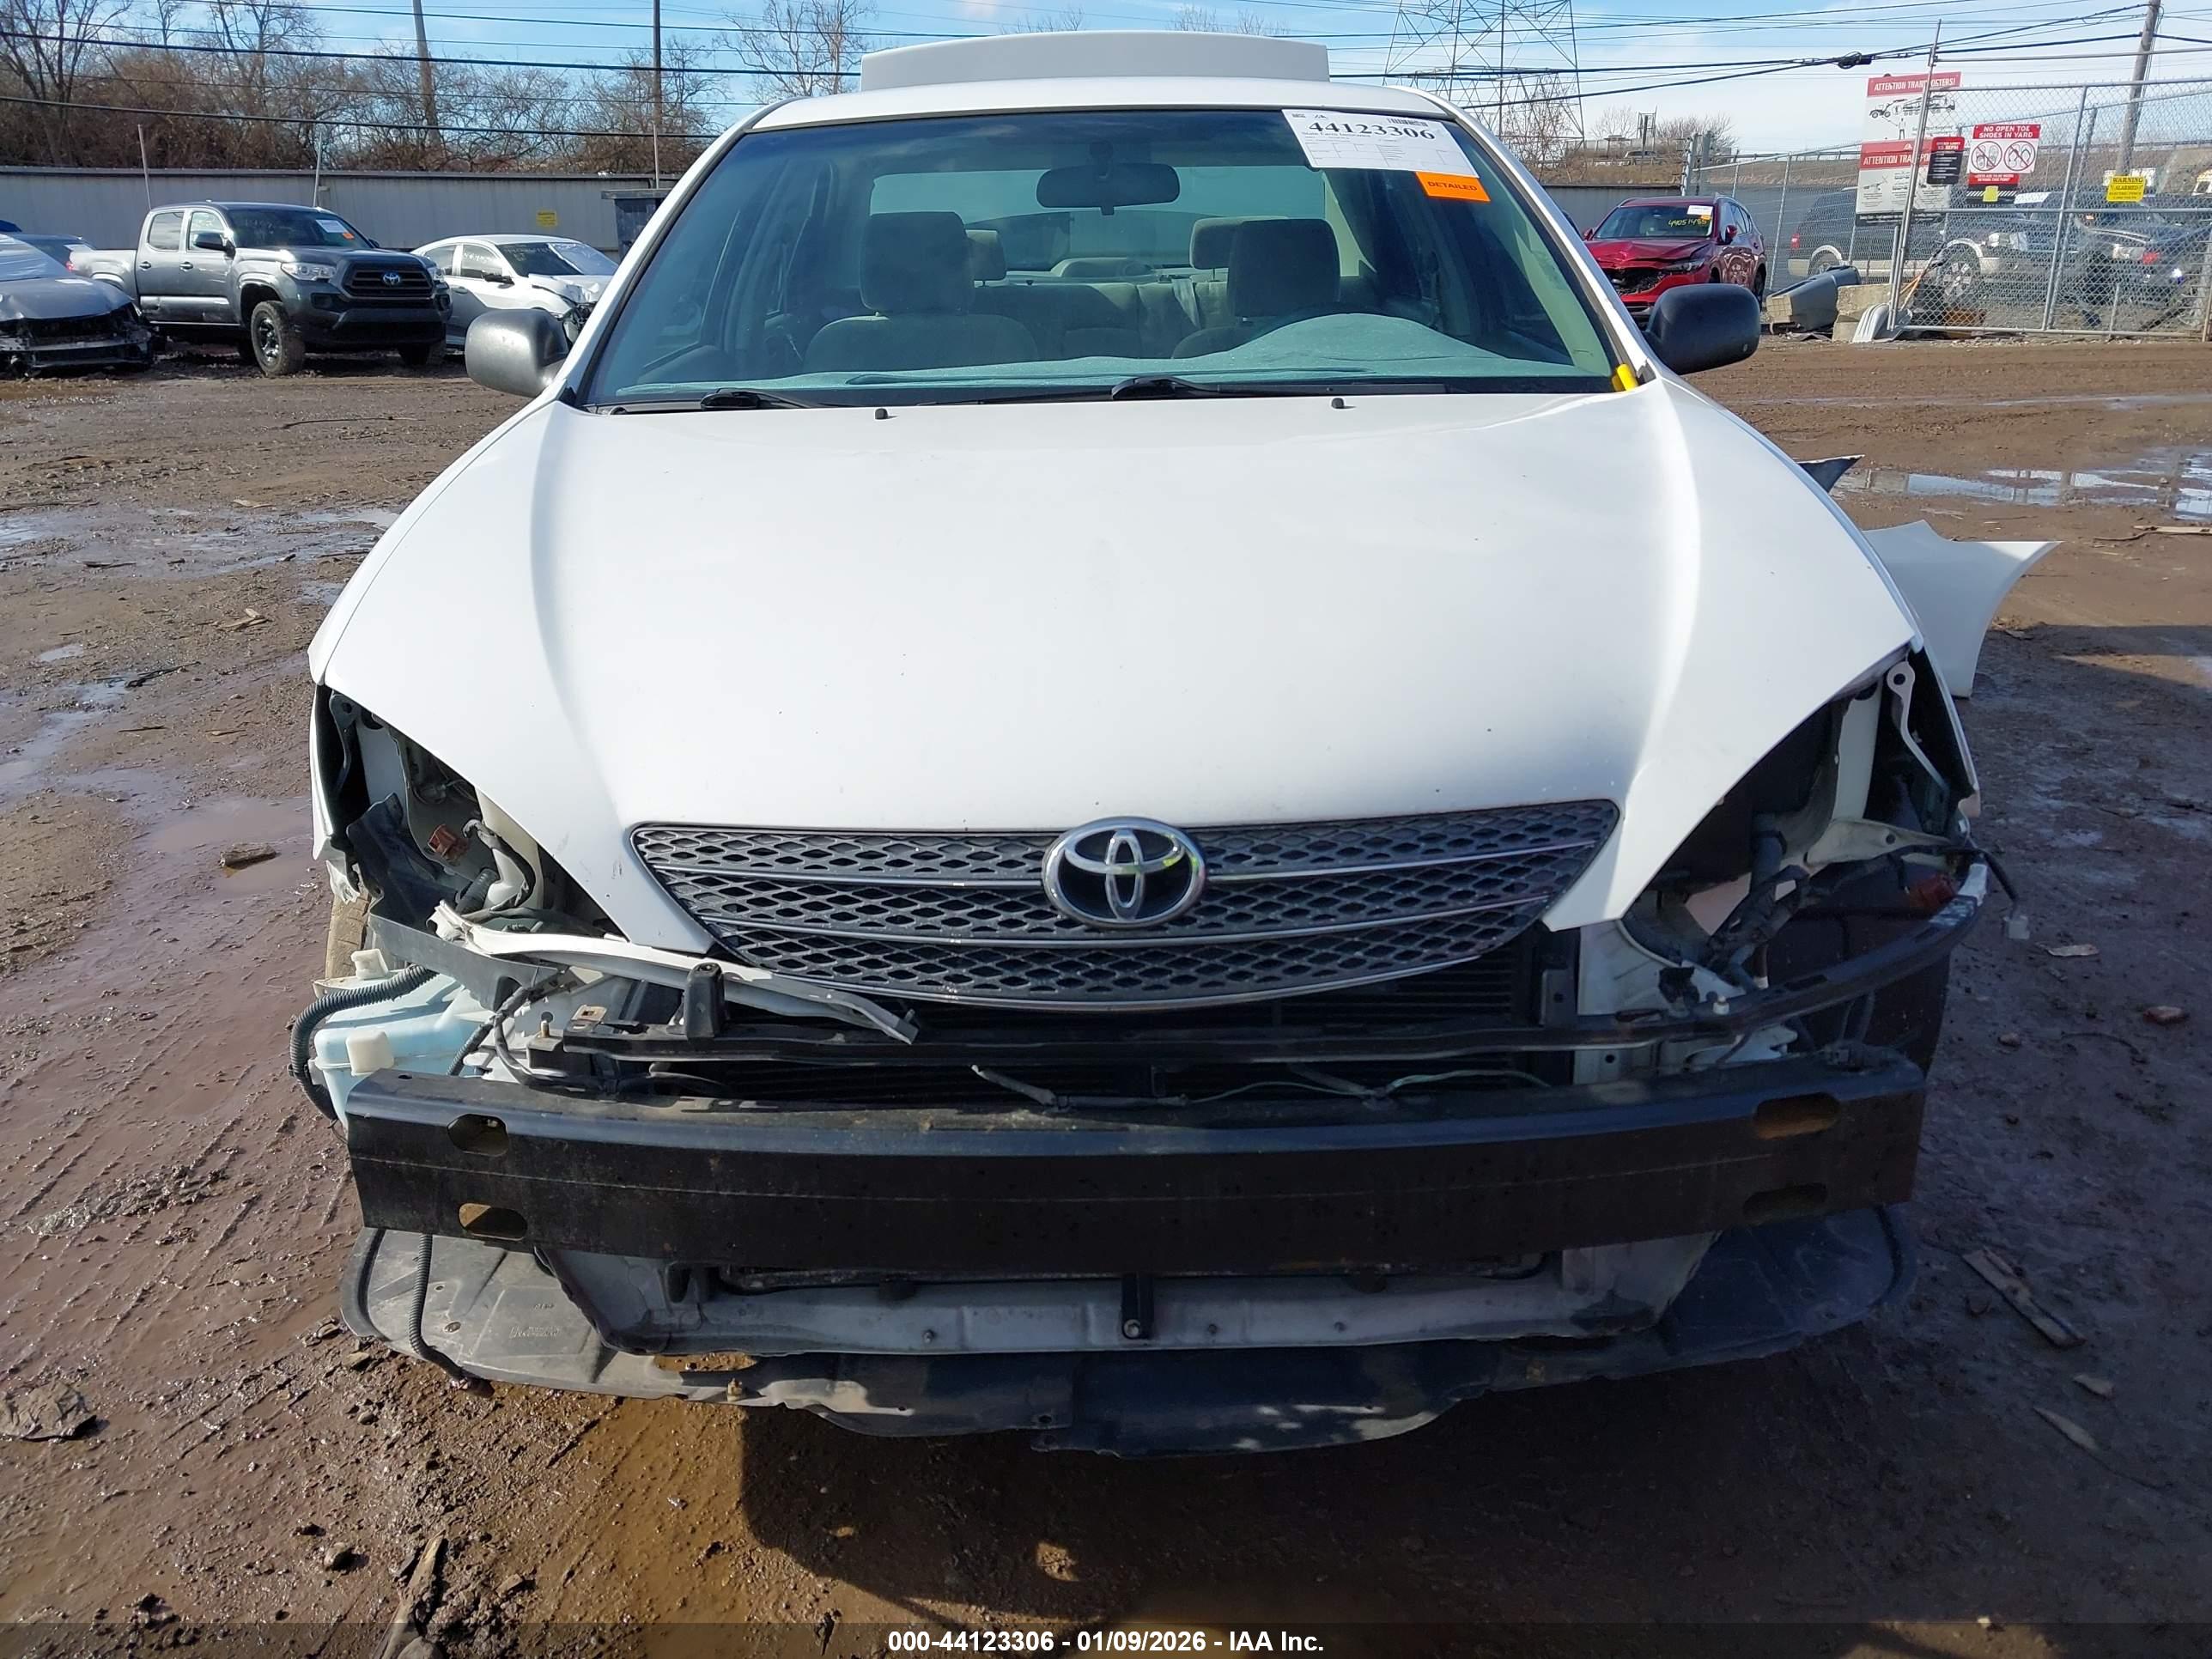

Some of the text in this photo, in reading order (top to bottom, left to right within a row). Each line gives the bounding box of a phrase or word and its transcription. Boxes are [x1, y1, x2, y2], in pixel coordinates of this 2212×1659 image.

[1875, 82, 1906, 92] ATTENTION
[1309, 122, 1435, 140] 44123306
[1863, 155, 1898, 166] ATTENTION
[1427, 181, 1478, 191] DETAILED
